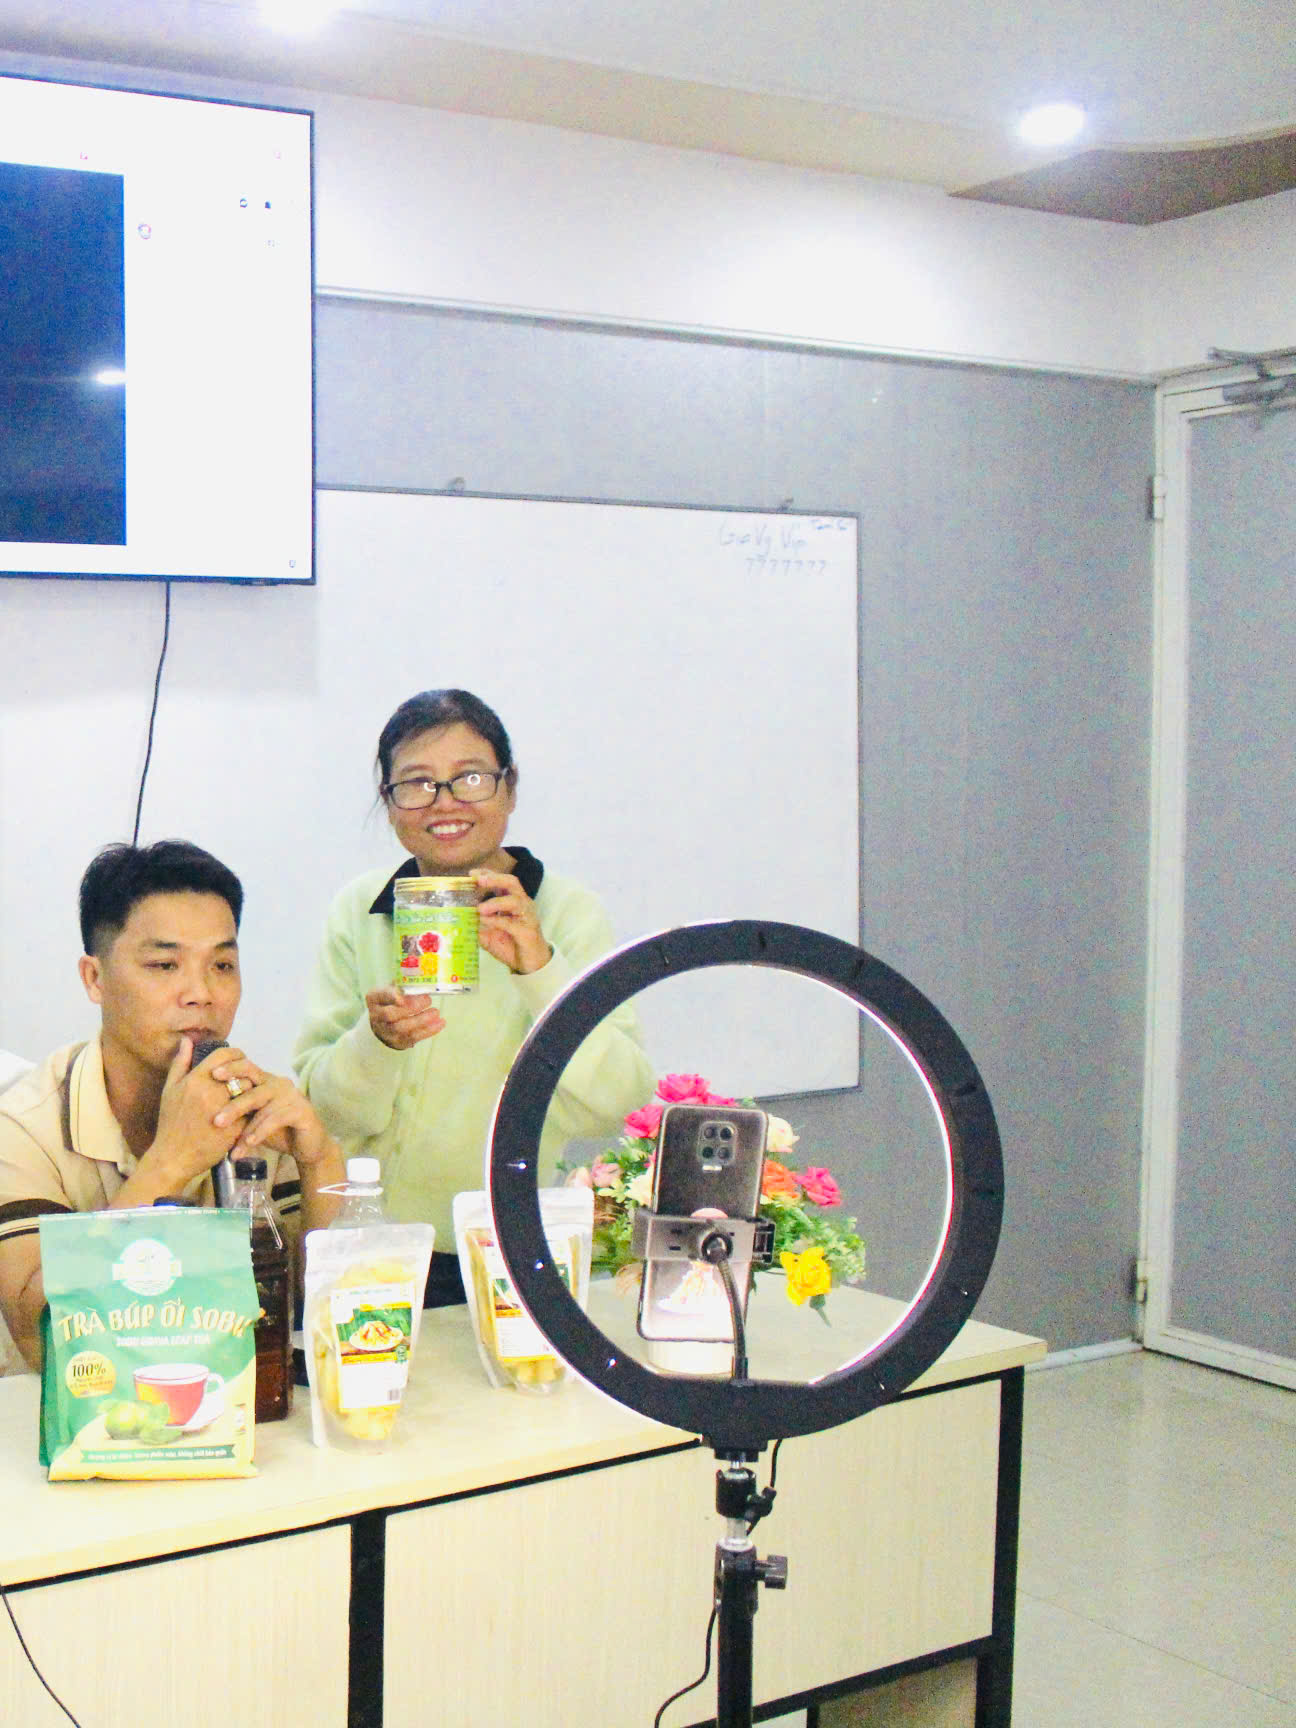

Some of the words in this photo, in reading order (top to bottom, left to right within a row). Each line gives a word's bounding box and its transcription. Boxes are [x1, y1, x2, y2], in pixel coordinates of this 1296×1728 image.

[58, 1307, 107, 1343] TRÀ
[108, 1300, 156, 1332] BÚP
[72, 1362, 107, 1378] 100%
